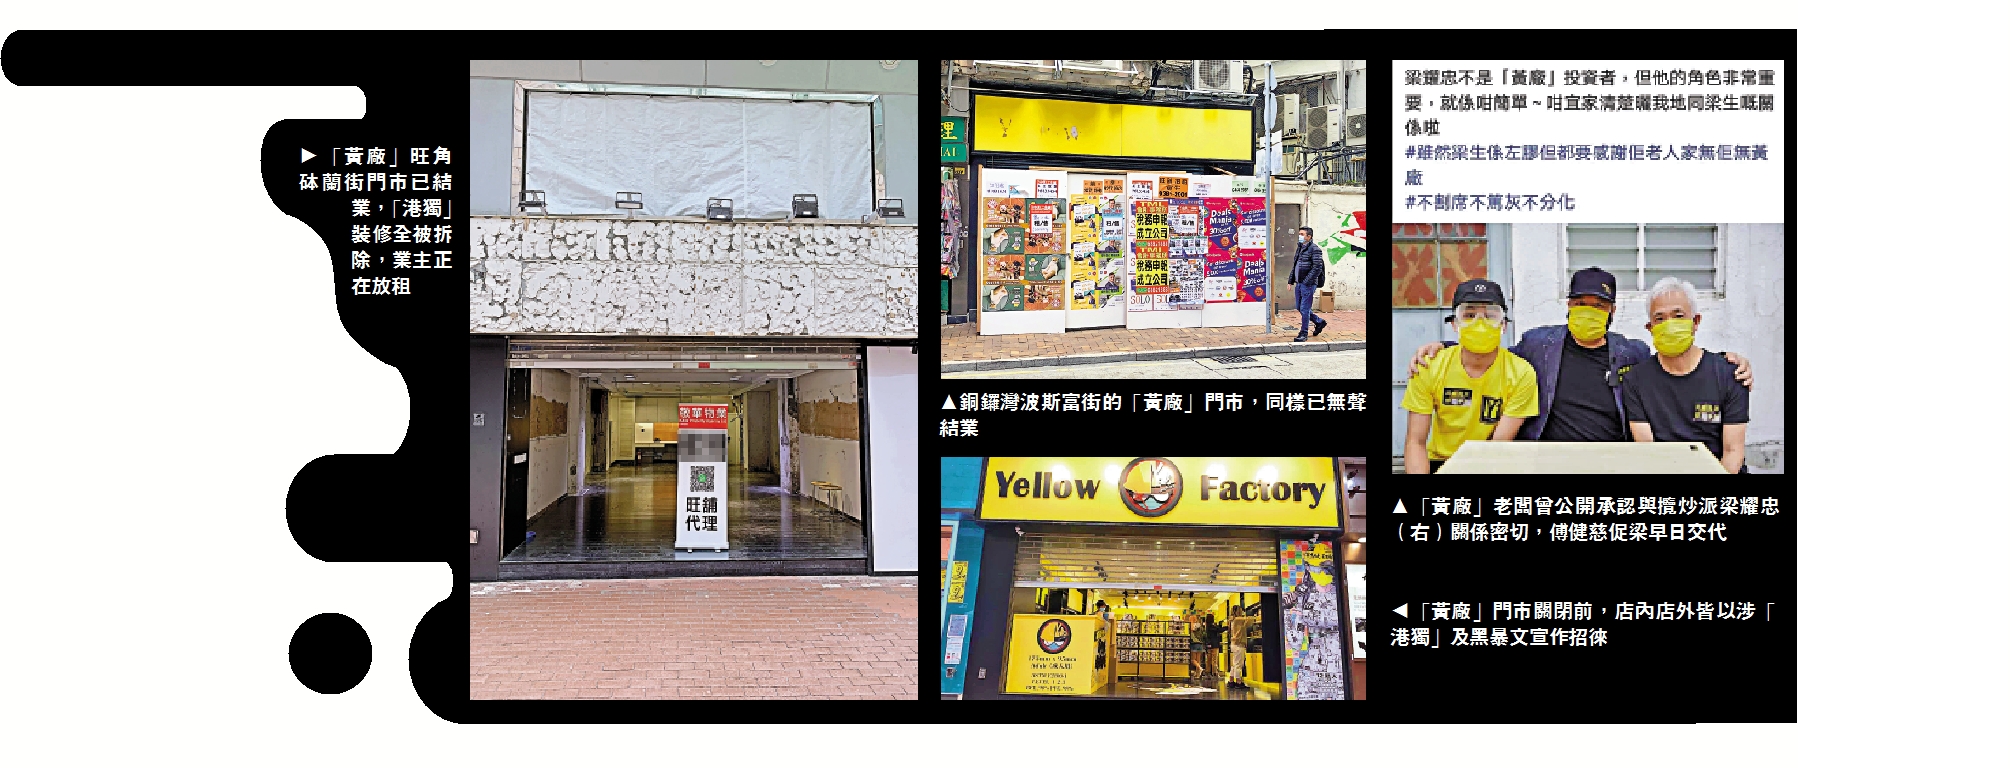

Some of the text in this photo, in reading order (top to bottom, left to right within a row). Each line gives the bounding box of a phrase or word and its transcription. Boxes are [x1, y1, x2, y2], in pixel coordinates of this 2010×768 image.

[1136, 227, 1168, 239] 成立公司
[1136, 259, 1168, 271] 稅務申報
[1136, 273, 1168, 285] 成立公司
[996, 471, 1326, 509] Yellow Factory
[685, 515, 718, 531] 代理
